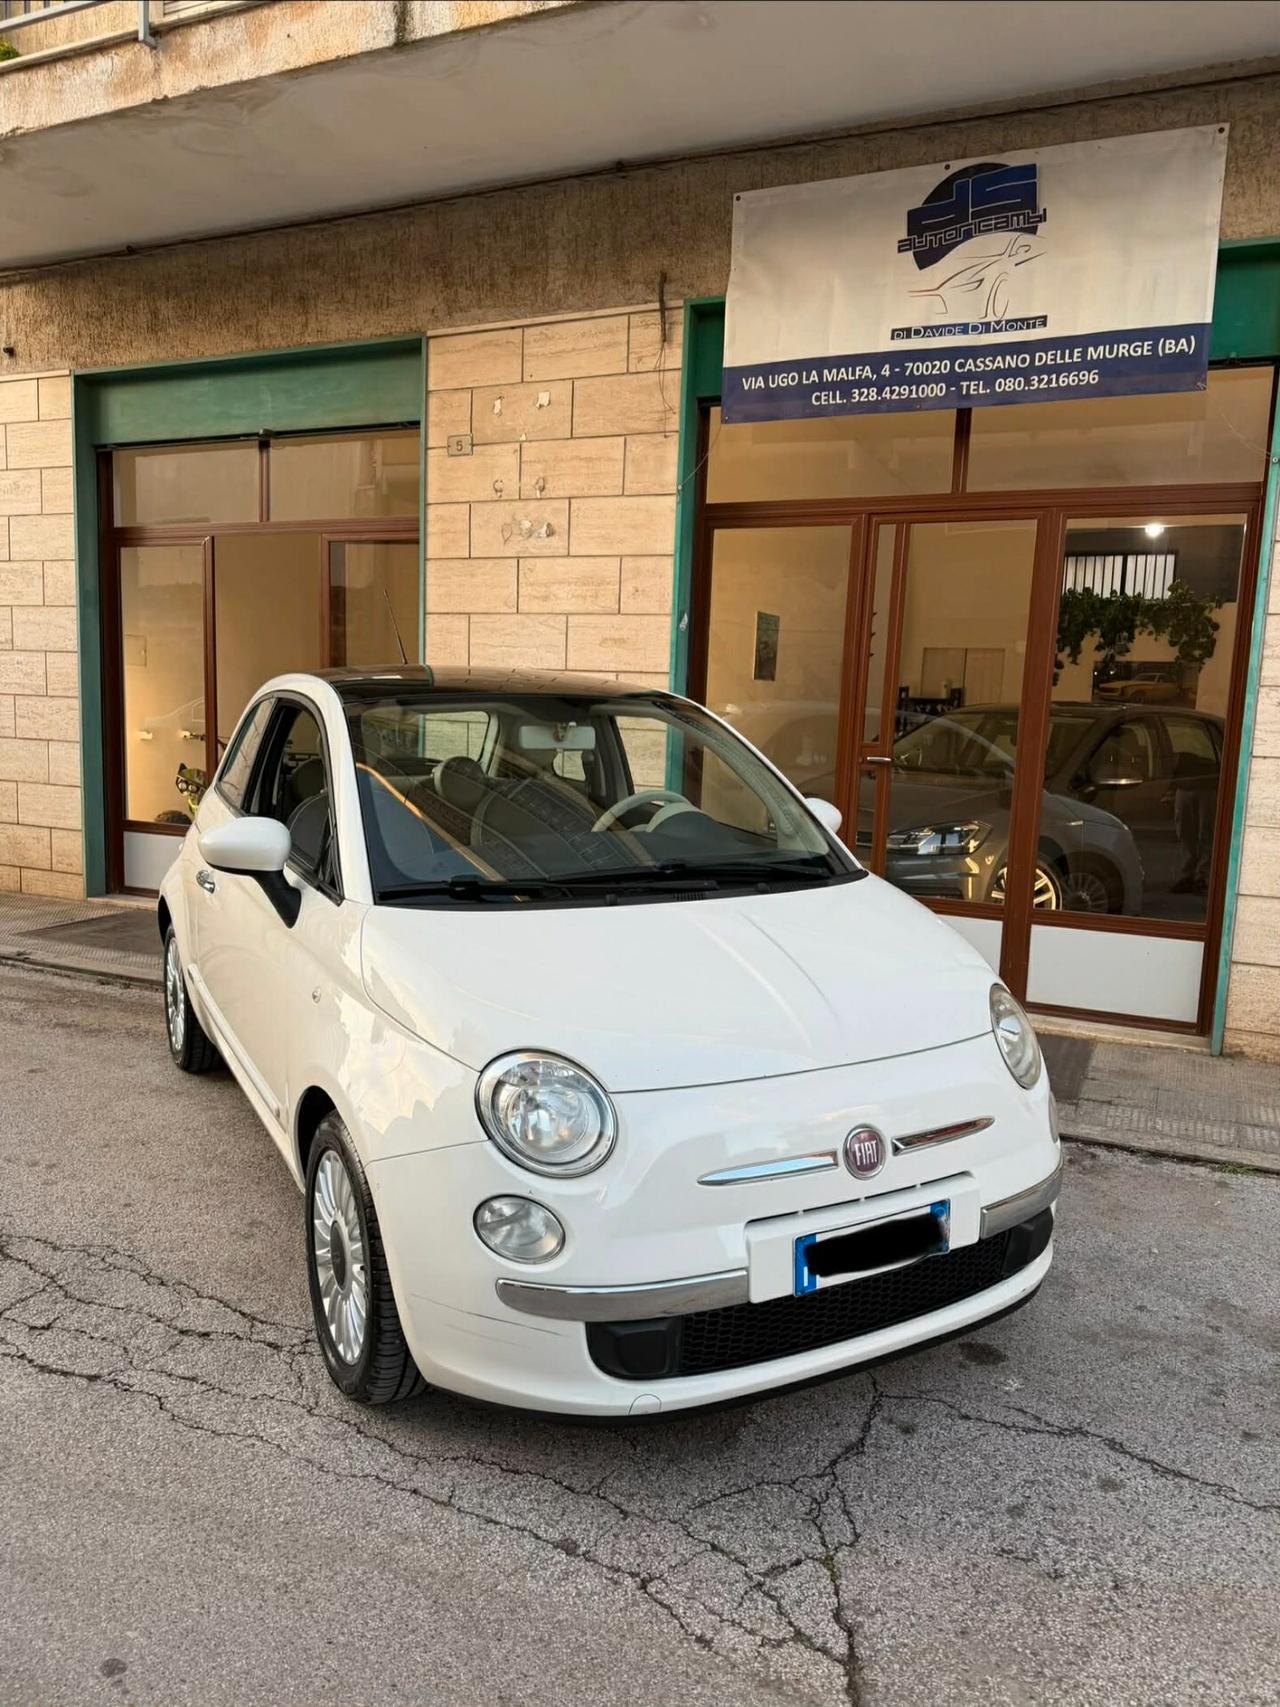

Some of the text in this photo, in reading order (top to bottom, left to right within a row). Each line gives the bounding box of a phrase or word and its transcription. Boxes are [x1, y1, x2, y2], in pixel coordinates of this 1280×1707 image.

[742, 377, 764, 391] VIA
[768, 372, 799, 388] UGO
[802, 370, 819, 384] LA
[823, 364, 877, 383] MALFA,
[881, 364, 890, 378] 4
[904, 360, 950, 376] 70020
[954, 354, 1030, 373] CASSANO
[1034, 348, 1082, 366] DELLE
[1087, 340, 1153, 360] MURGE
[1157, 335, 1196, 357] (BA)
[811, 391, 847, 405] CELL.
[851, 383, 946, 402] 328.4291000
[960, 380, 990, 395] TEL.
[995, 370, 1099, 393] 080.3216696
[854, 1140, 877, 1166] FIAT
